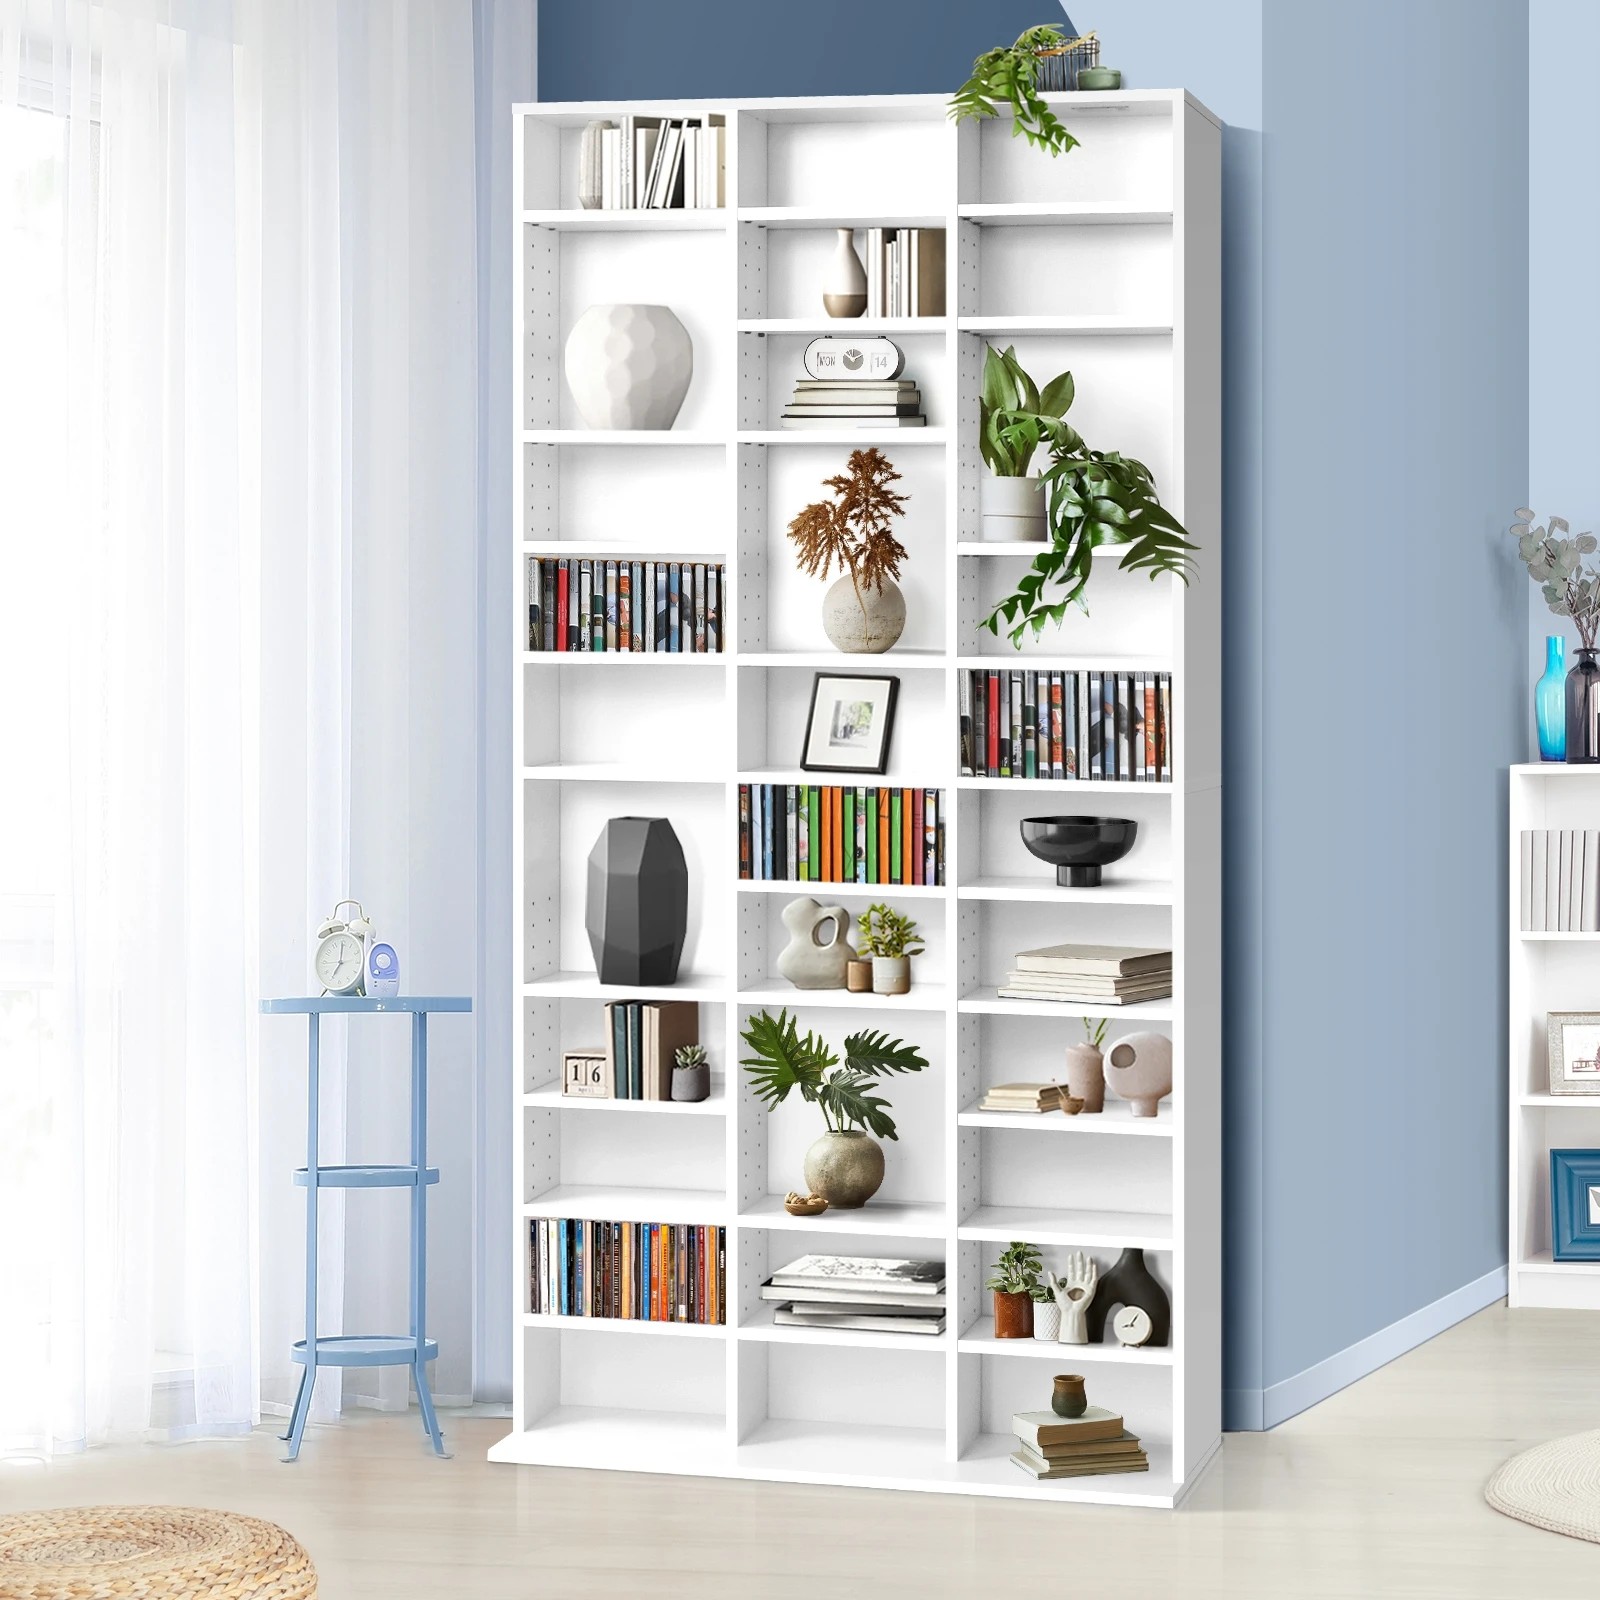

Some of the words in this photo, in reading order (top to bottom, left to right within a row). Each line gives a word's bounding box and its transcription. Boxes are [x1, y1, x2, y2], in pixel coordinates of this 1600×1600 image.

[874, 355, 888, 368] 14
[572, 1064, 579, 1081] 1
[591, 1065, 601, 1083] 6
